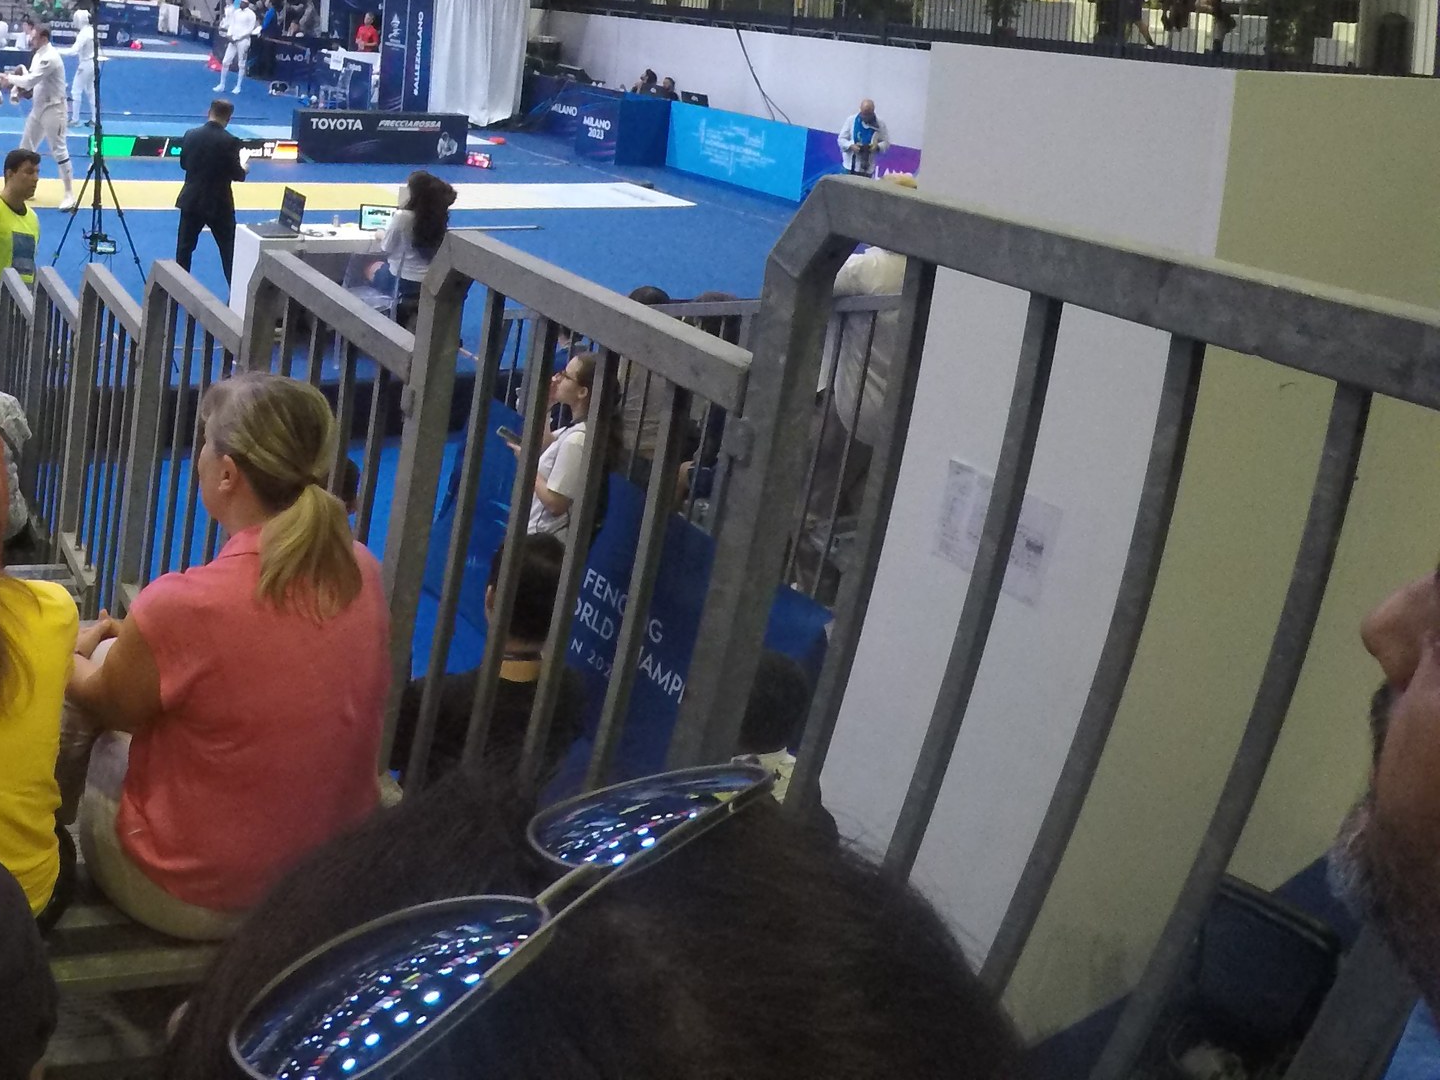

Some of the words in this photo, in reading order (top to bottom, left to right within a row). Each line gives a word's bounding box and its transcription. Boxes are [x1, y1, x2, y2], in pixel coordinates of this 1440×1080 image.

[310, 117, 363, 131] TOYOTA
[378, 119, 442, 128] FRECCIAROSSA
[582, 115, 611, 131] MILANO
[587, 127, 604, 140] 2023
